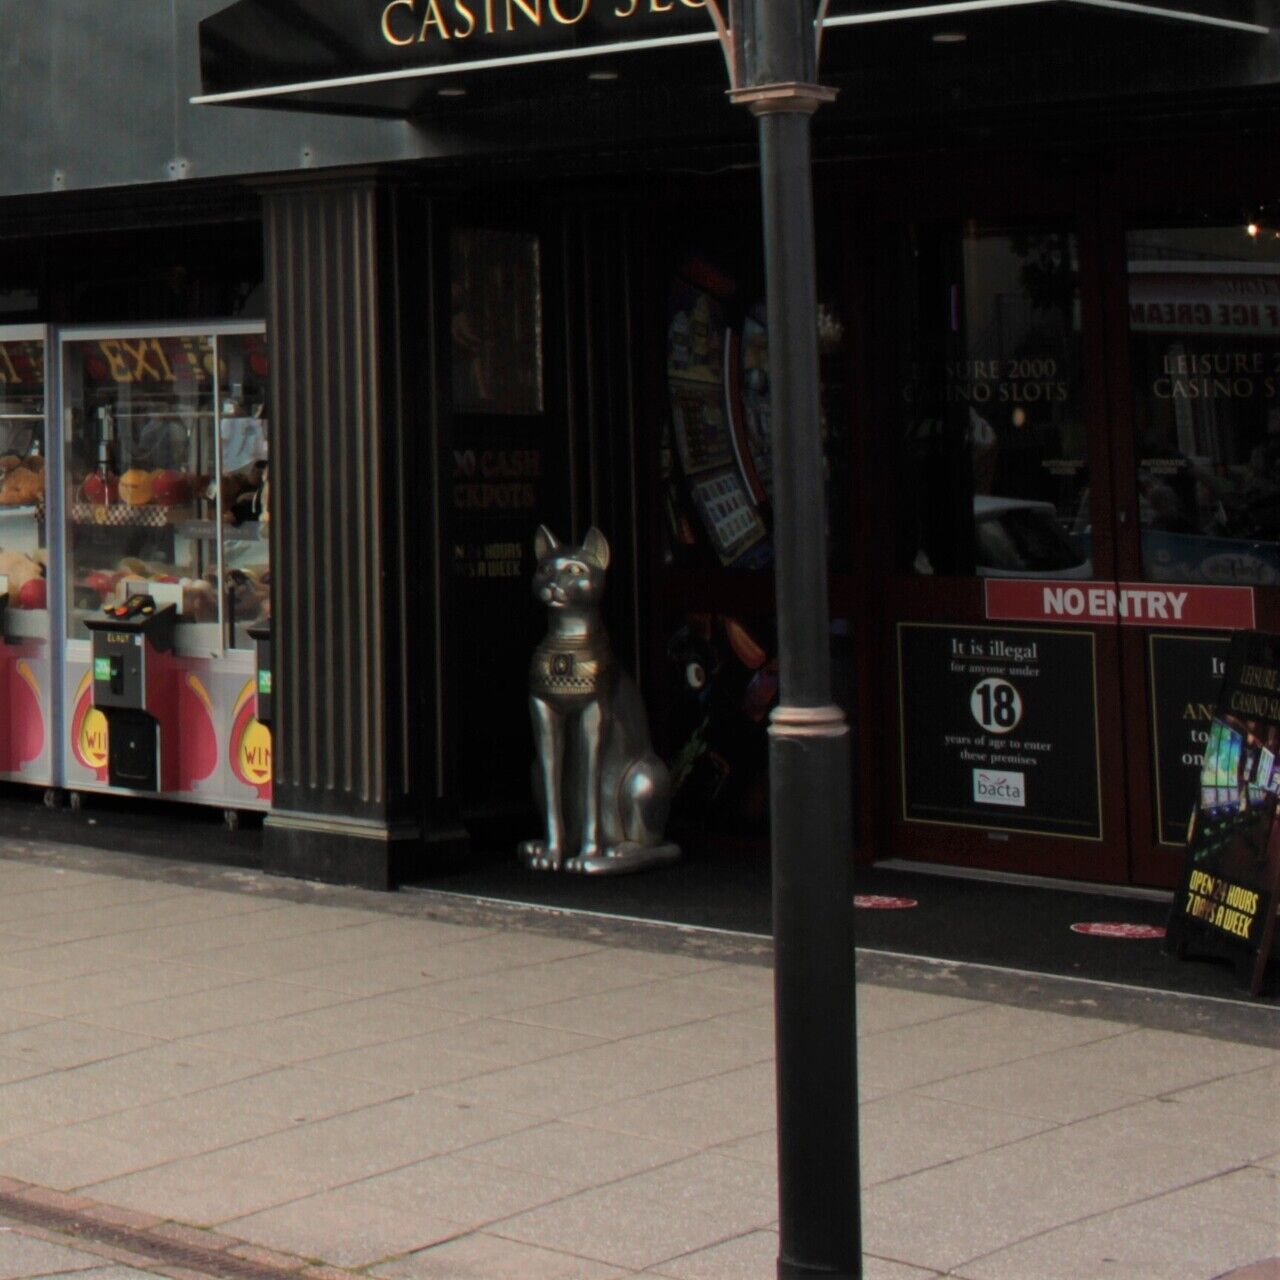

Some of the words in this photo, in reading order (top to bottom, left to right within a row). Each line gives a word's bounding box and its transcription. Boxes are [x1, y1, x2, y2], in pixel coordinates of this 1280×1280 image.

[1042, 586, 1086, 616] NO
[1088, 588, 1189, 620] ENTRY
[951, 638, 965, 655] It
[970, 639, 984, 656] is
[990, 640, 1038, 662] illegal
[950, 661, 966, 673] for
[969, 664, 1007, 677] anyone
[1008, 664, 1040, 677] under
[1211, 656, 1226, 675] It
[976, 683, 1017, 728] 18
[944, 734, 971, 746] years
[974, 734, 986, 745] of
[989, 737, 1007, 749] age
[1009, 738, 1021, 749] to
[1023, 740, 1052, 752] enter
[960, 748, 988, 762] these
[990, 752, 1038, 766] premises
[977, 780, 1021, 799] bacta
[1189, 868, 1215, 897] OPEN
[1225, 882, 1259, 916] HOURS
[1223, 904, 1253, 939] WEEK
